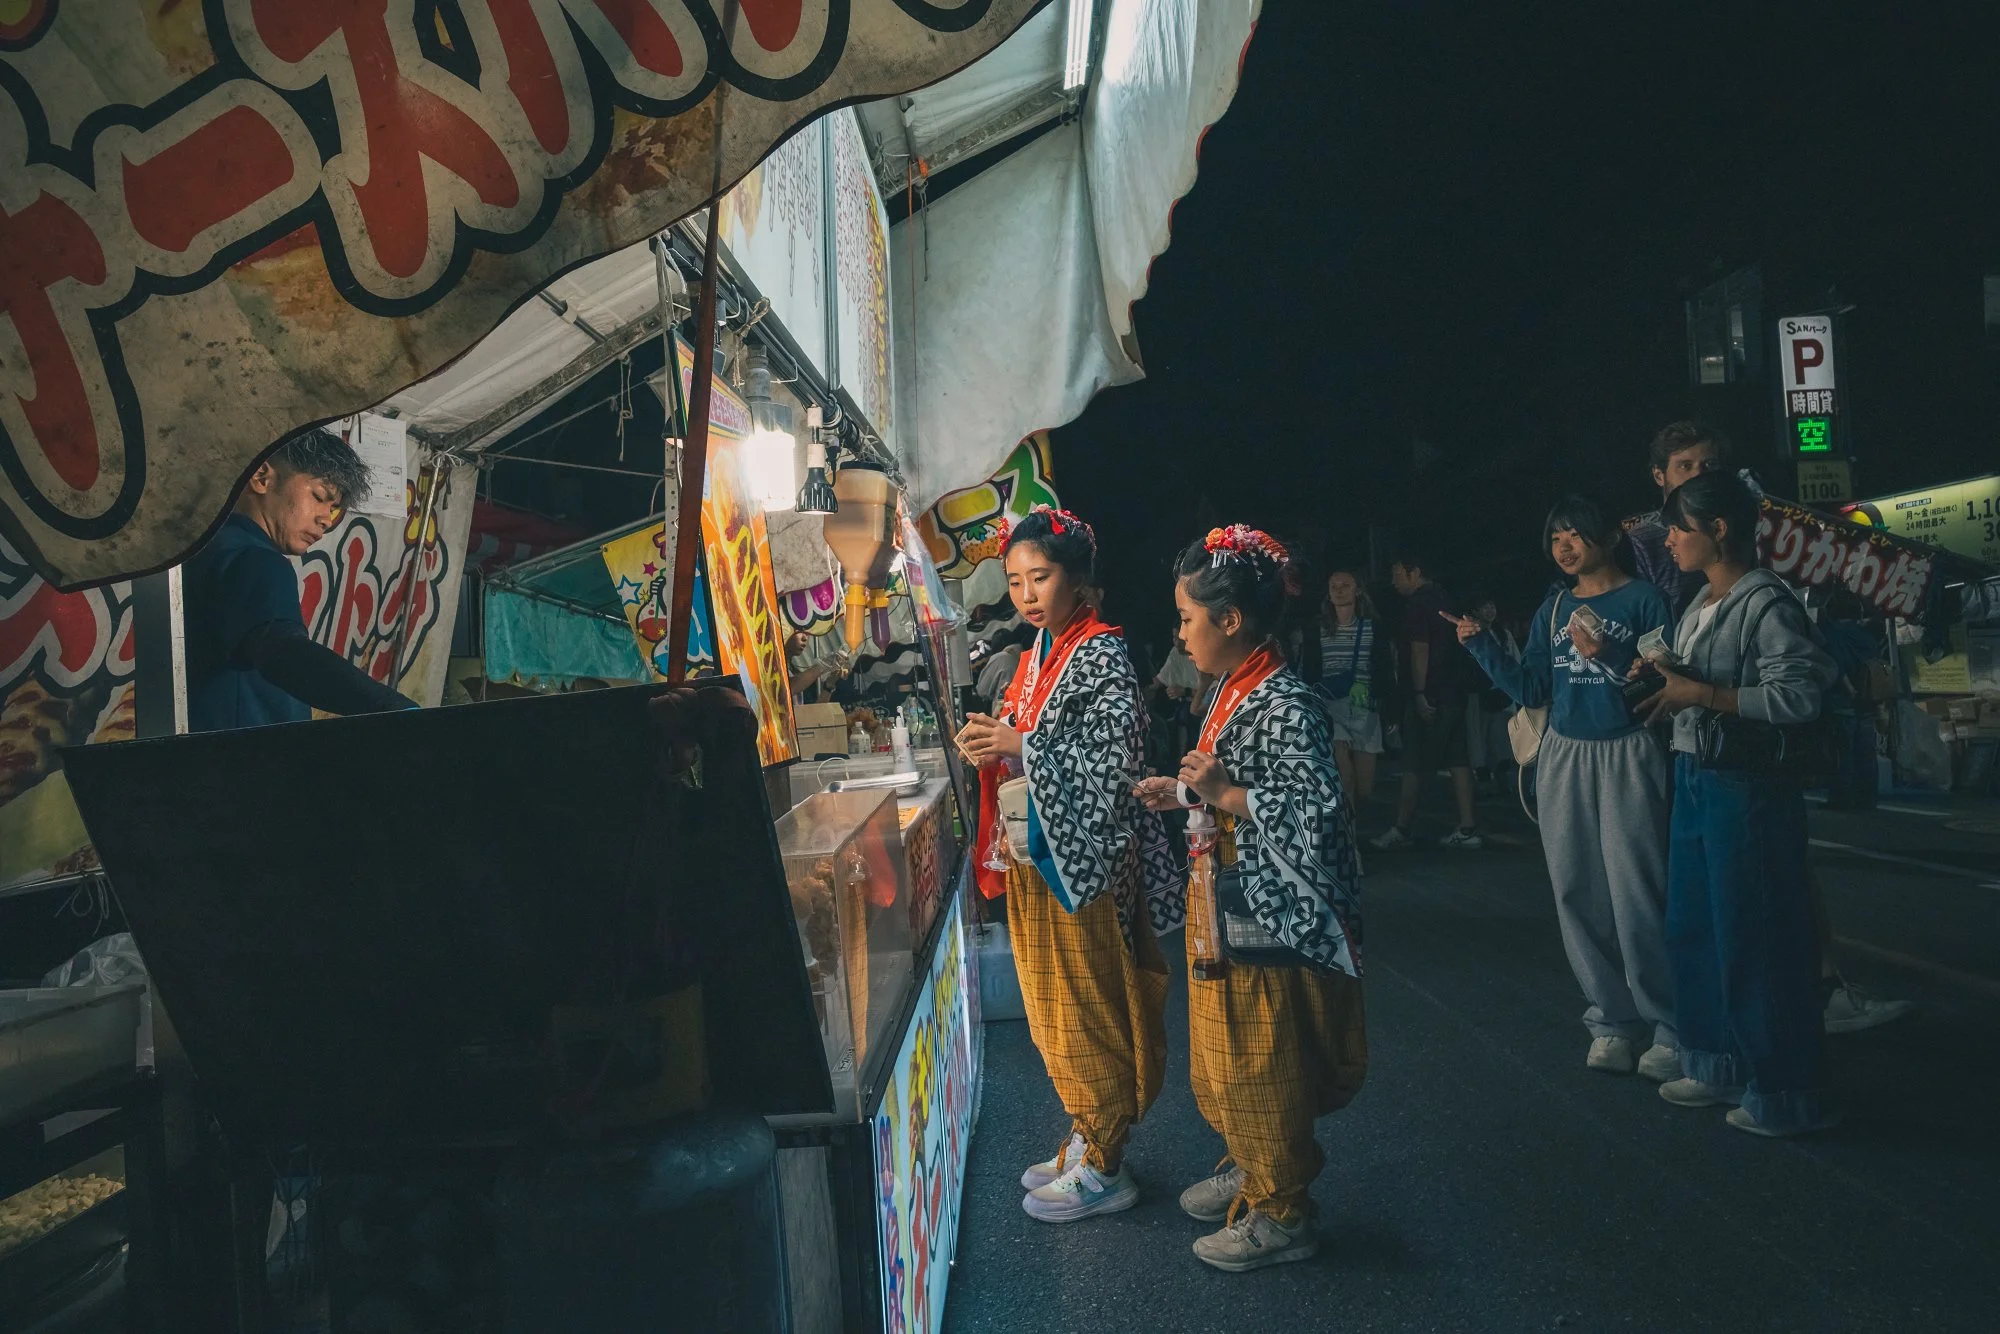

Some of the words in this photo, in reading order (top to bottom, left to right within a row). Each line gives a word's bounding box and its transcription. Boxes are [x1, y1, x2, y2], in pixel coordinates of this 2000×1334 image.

[1786, 321, 1828, 335] SANパーク
[1791, 338, 1825, 386] P
[1791, 390, 1834, 415] 時間貸
[1797, 418, 1828, 451] 空
[1801, 482, 1841, 500] 1100
[1553, 619, 1633, 647] BRLYN
